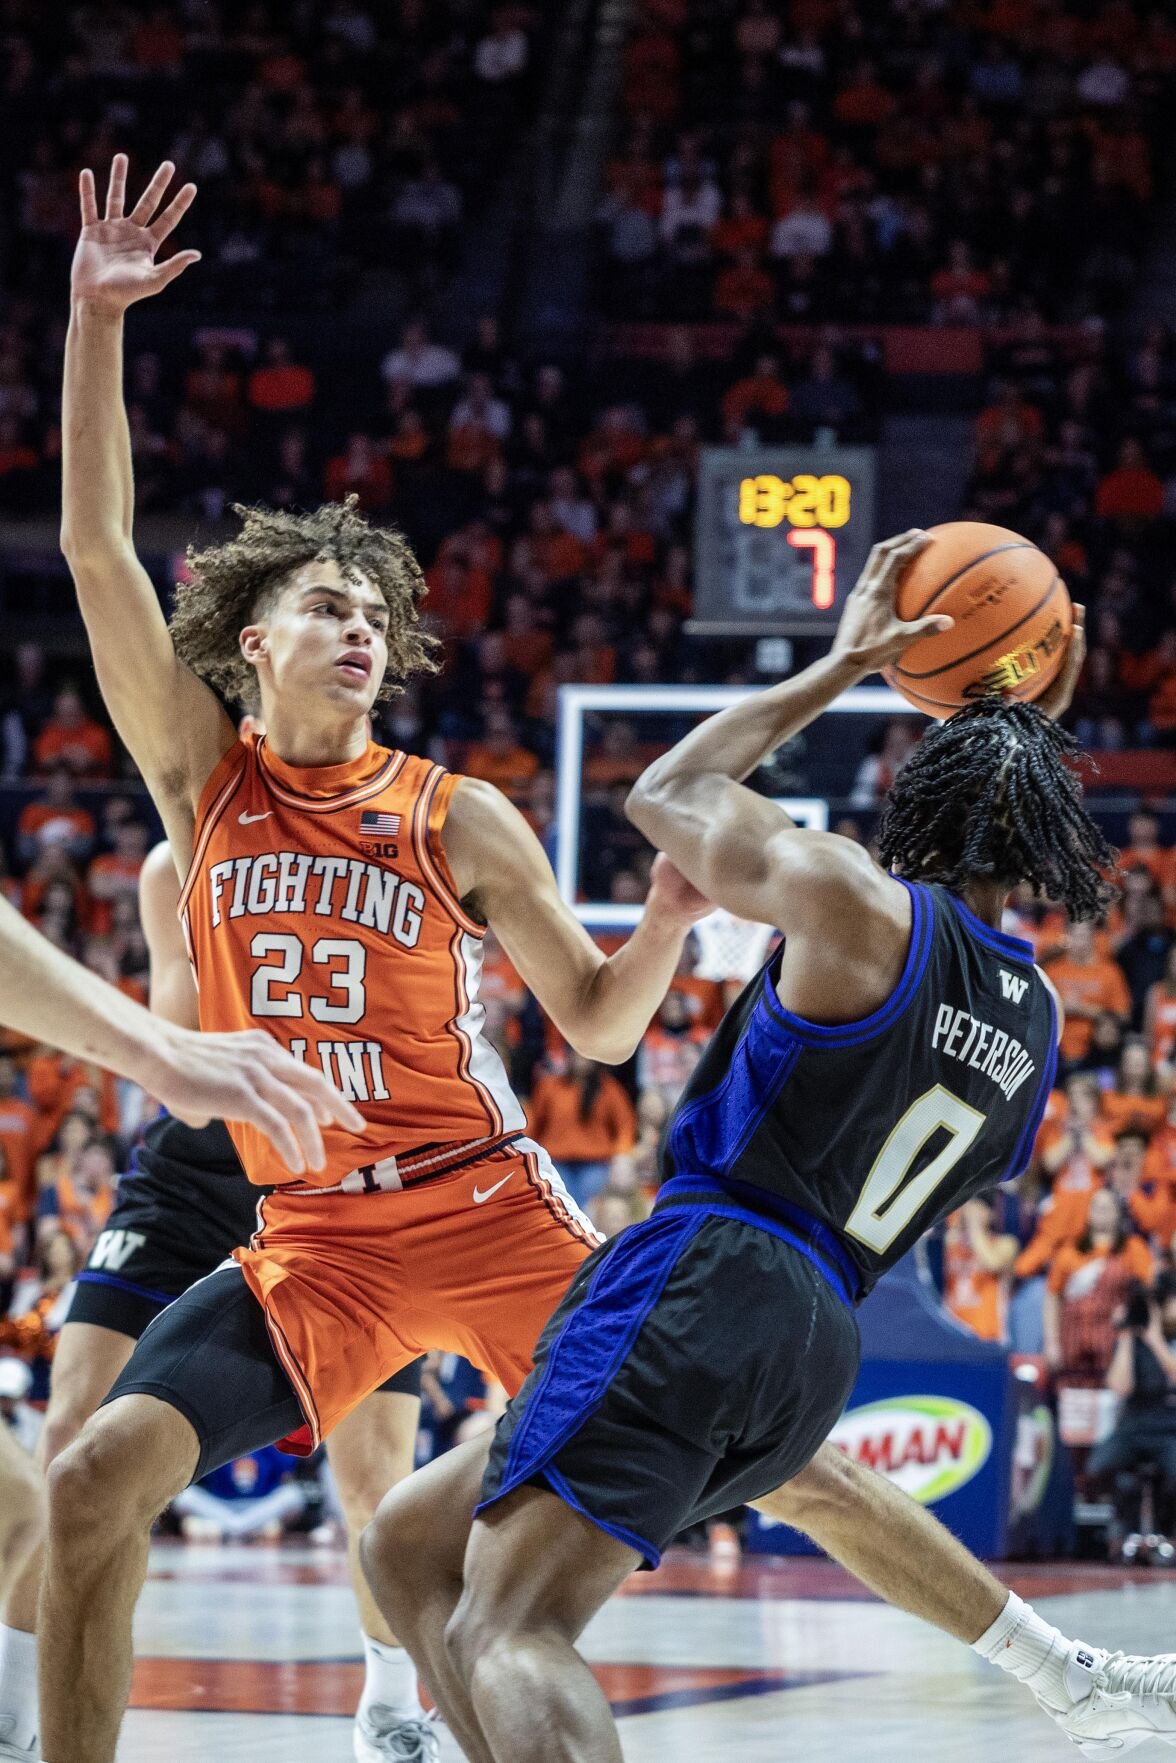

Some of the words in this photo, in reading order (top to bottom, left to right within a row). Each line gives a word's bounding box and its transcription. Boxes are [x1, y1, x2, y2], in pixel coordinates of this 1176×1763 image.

[739, 474, 851, 528] 13:20
[787, 528, 836, 610] 7
[210, 852, 425, 949] FIGHTING
[249, 932, 368, 1024] 23
[999, 968, 1029, 1004] W
[931, 1002, 1036, 1101] PETERSON
[844, 1082, 987, 1256] 0
[88, 1229, 147, 1271] W
[834, 1420, 967, 1471] MAN
